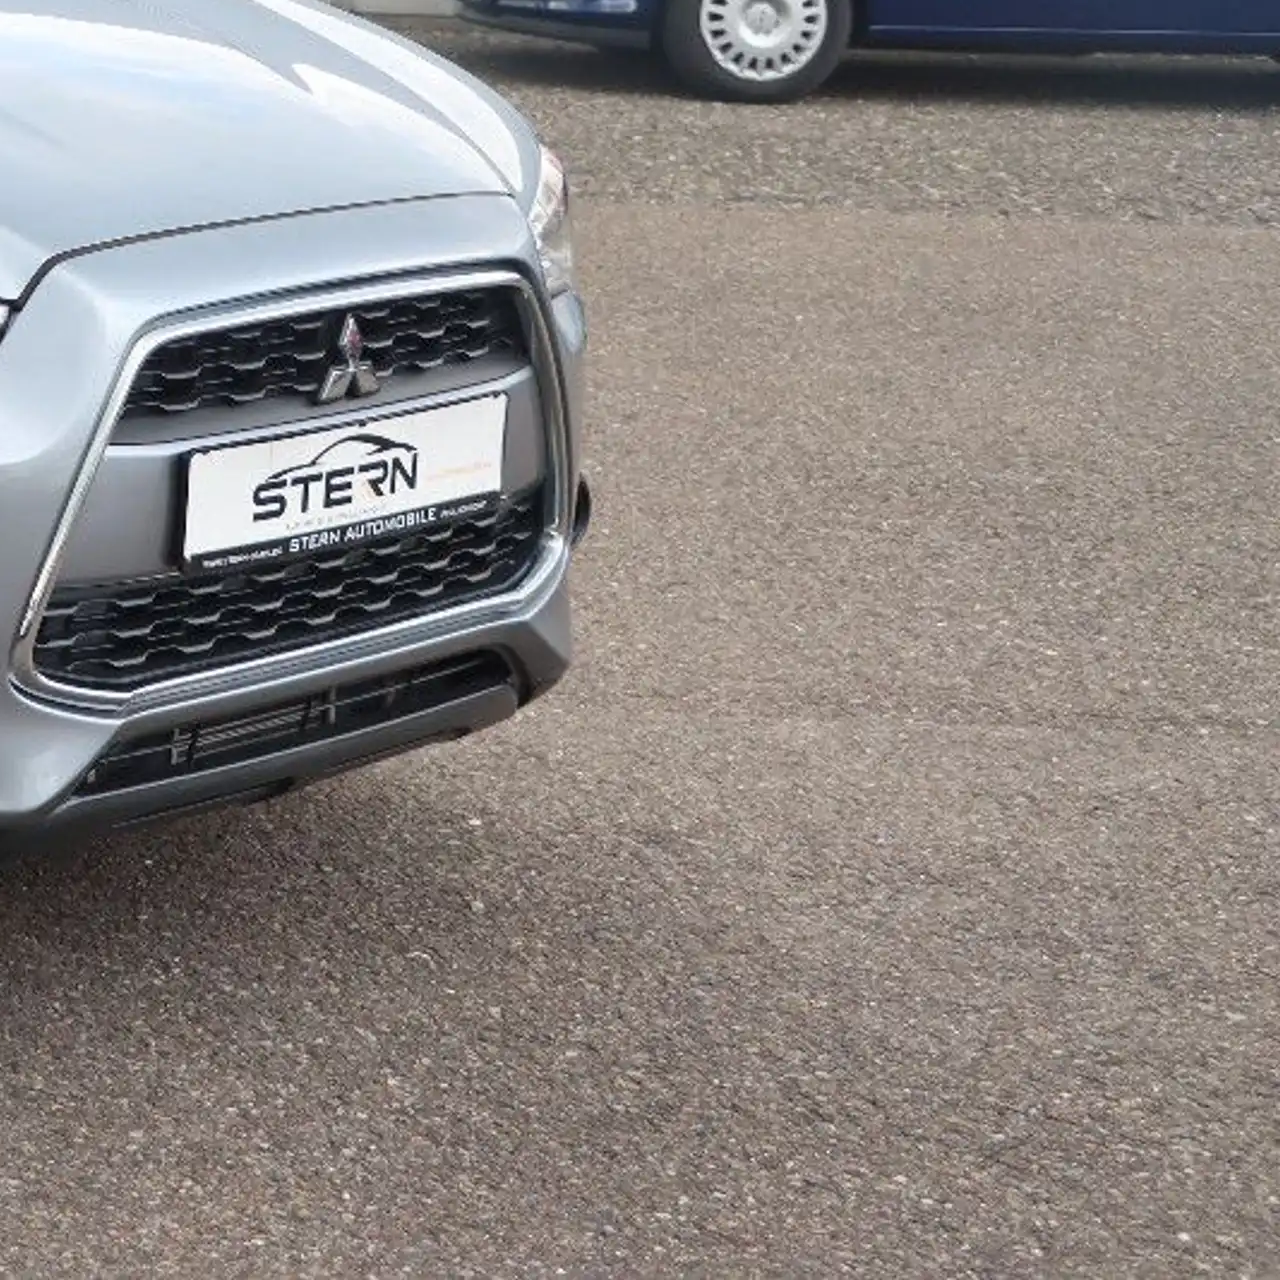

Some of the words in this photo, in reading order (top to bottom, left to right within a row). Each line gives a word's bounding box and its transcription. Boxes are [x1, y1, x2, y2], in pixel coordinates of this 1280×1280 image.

[252, 452, 418, 523] STERN
[289, 528, 341, 552] STERN
[344, 507, 438, 542] AUTOMOBILE
